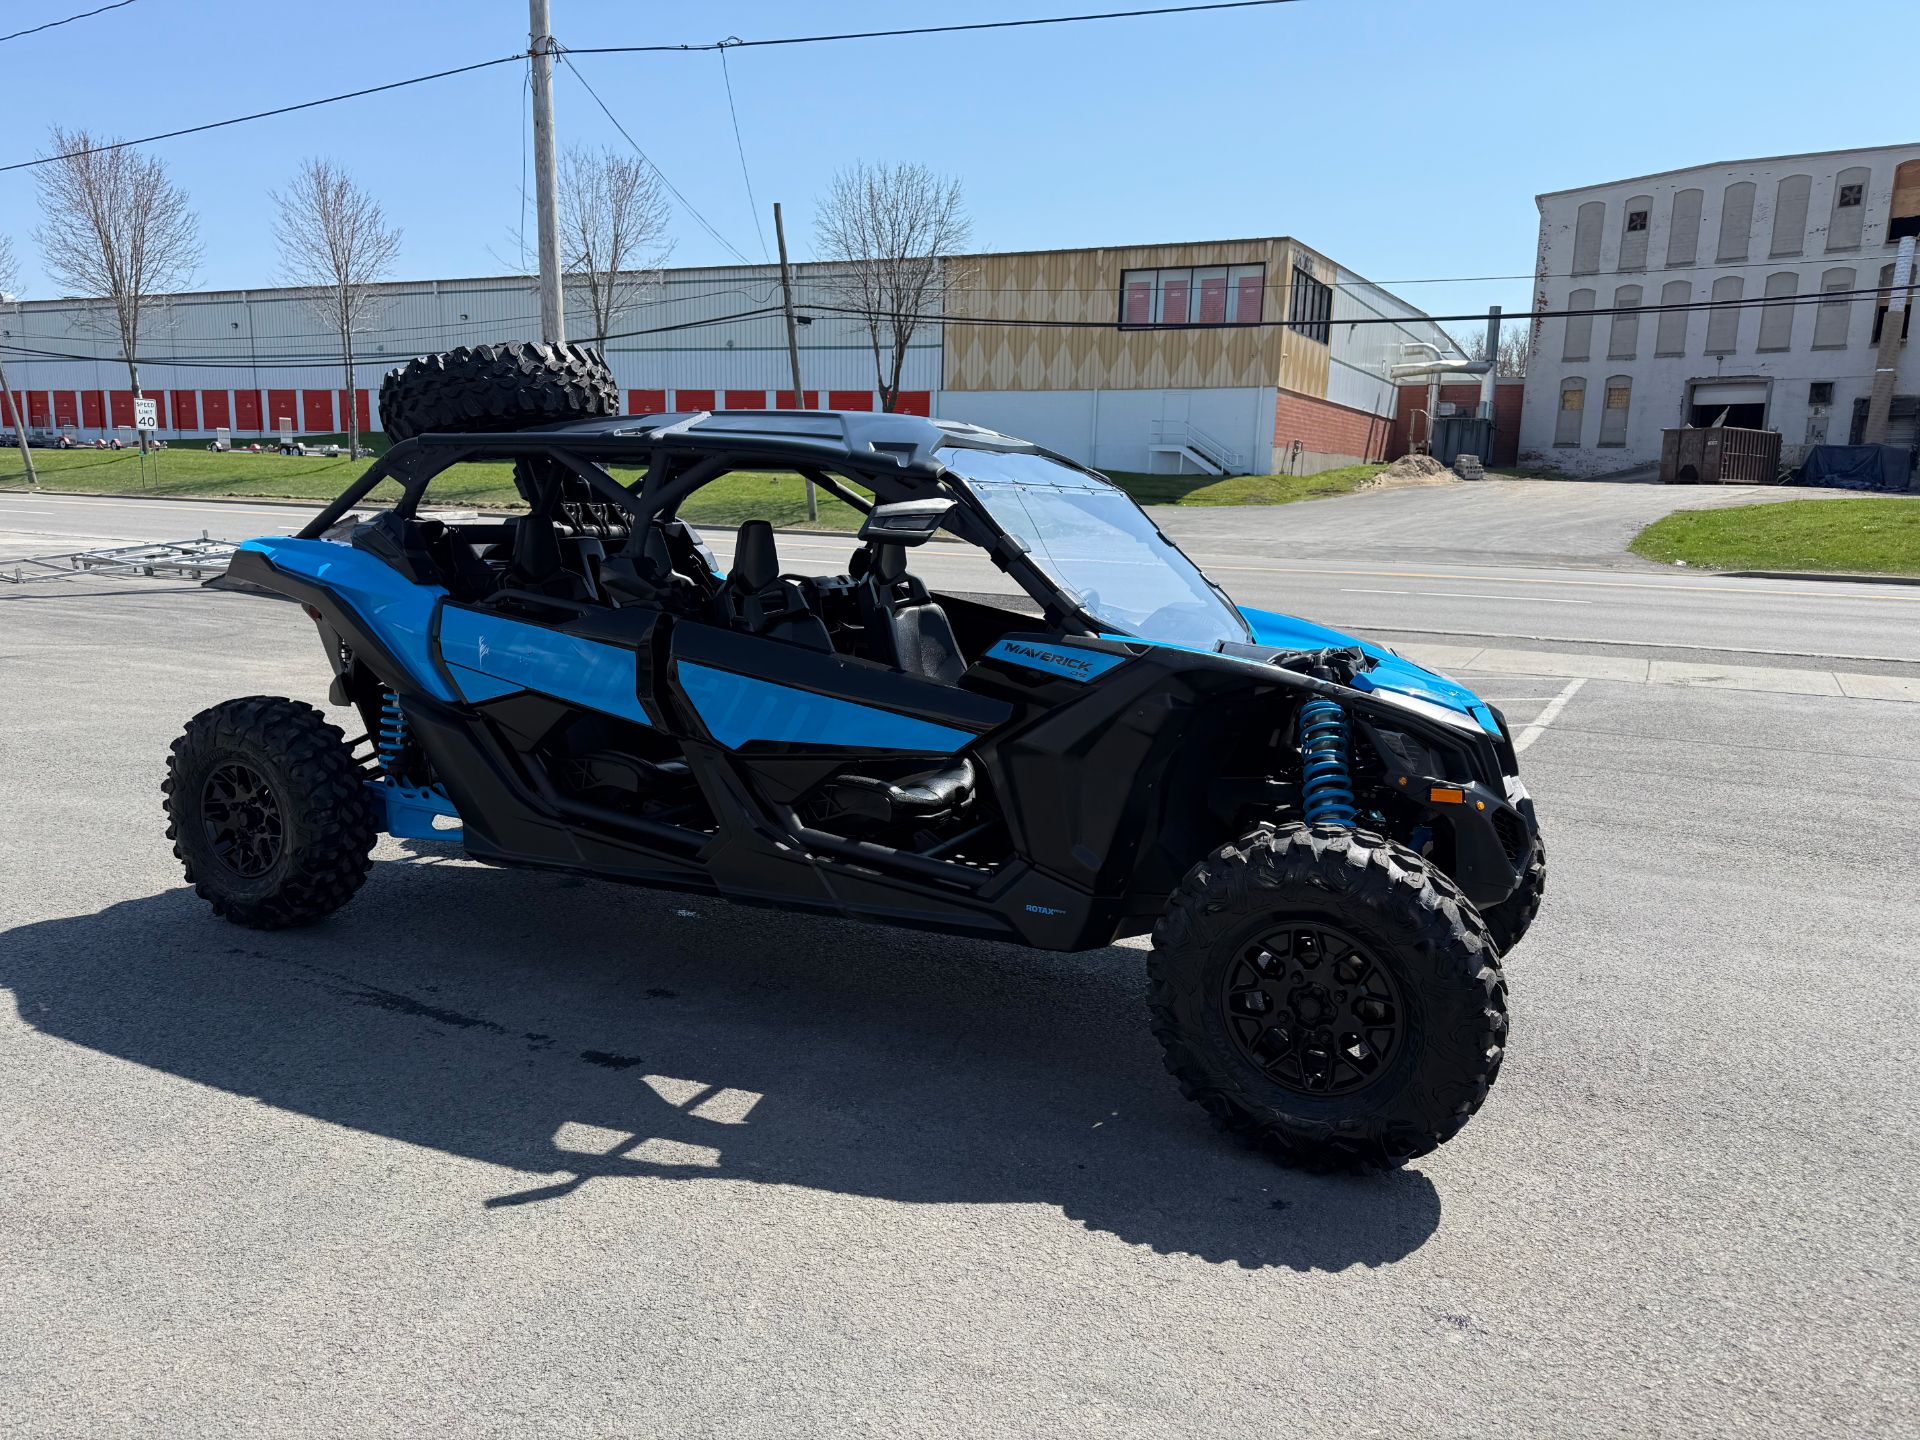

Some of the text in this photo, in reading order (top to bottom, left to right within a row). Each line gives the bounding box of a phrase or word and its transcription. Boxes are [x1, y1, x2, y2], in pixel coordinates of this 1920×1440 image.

[138, 416, 155, 427] 40
[1004, 642, 1094, 672] MAVERICK
[1025, 904, 1054, 915] ROTAX
